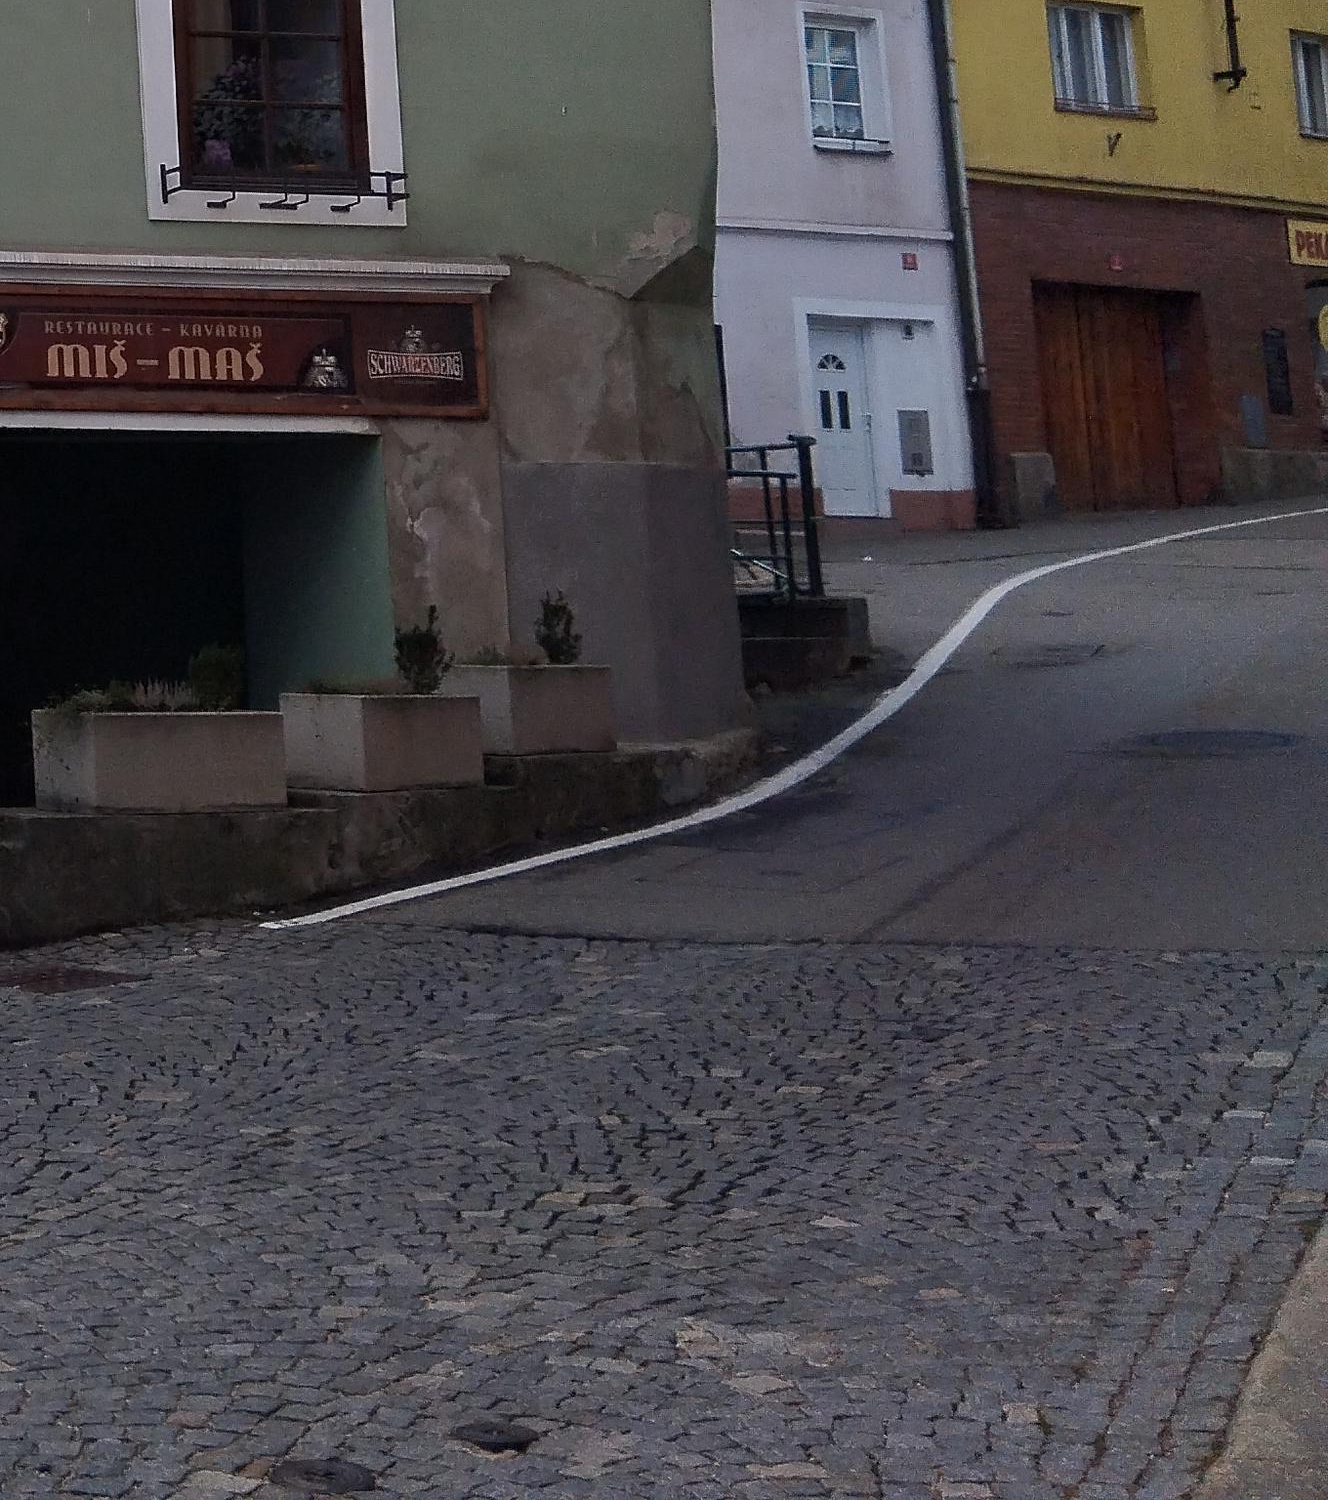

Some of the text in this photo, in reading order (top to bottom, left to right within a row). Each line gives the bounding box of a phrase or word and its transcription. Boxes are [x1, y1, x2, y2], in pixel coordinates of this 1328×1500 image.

[44, 320, 154, 336] RESTAURACE
[179, 321, 263, 338] KAVÁRNA
[46, 339, 128, 379] MIŠ
[167, 341, 264, 382] MAŠ
[370, 353, 461, 376] SCHWARZENBERG
